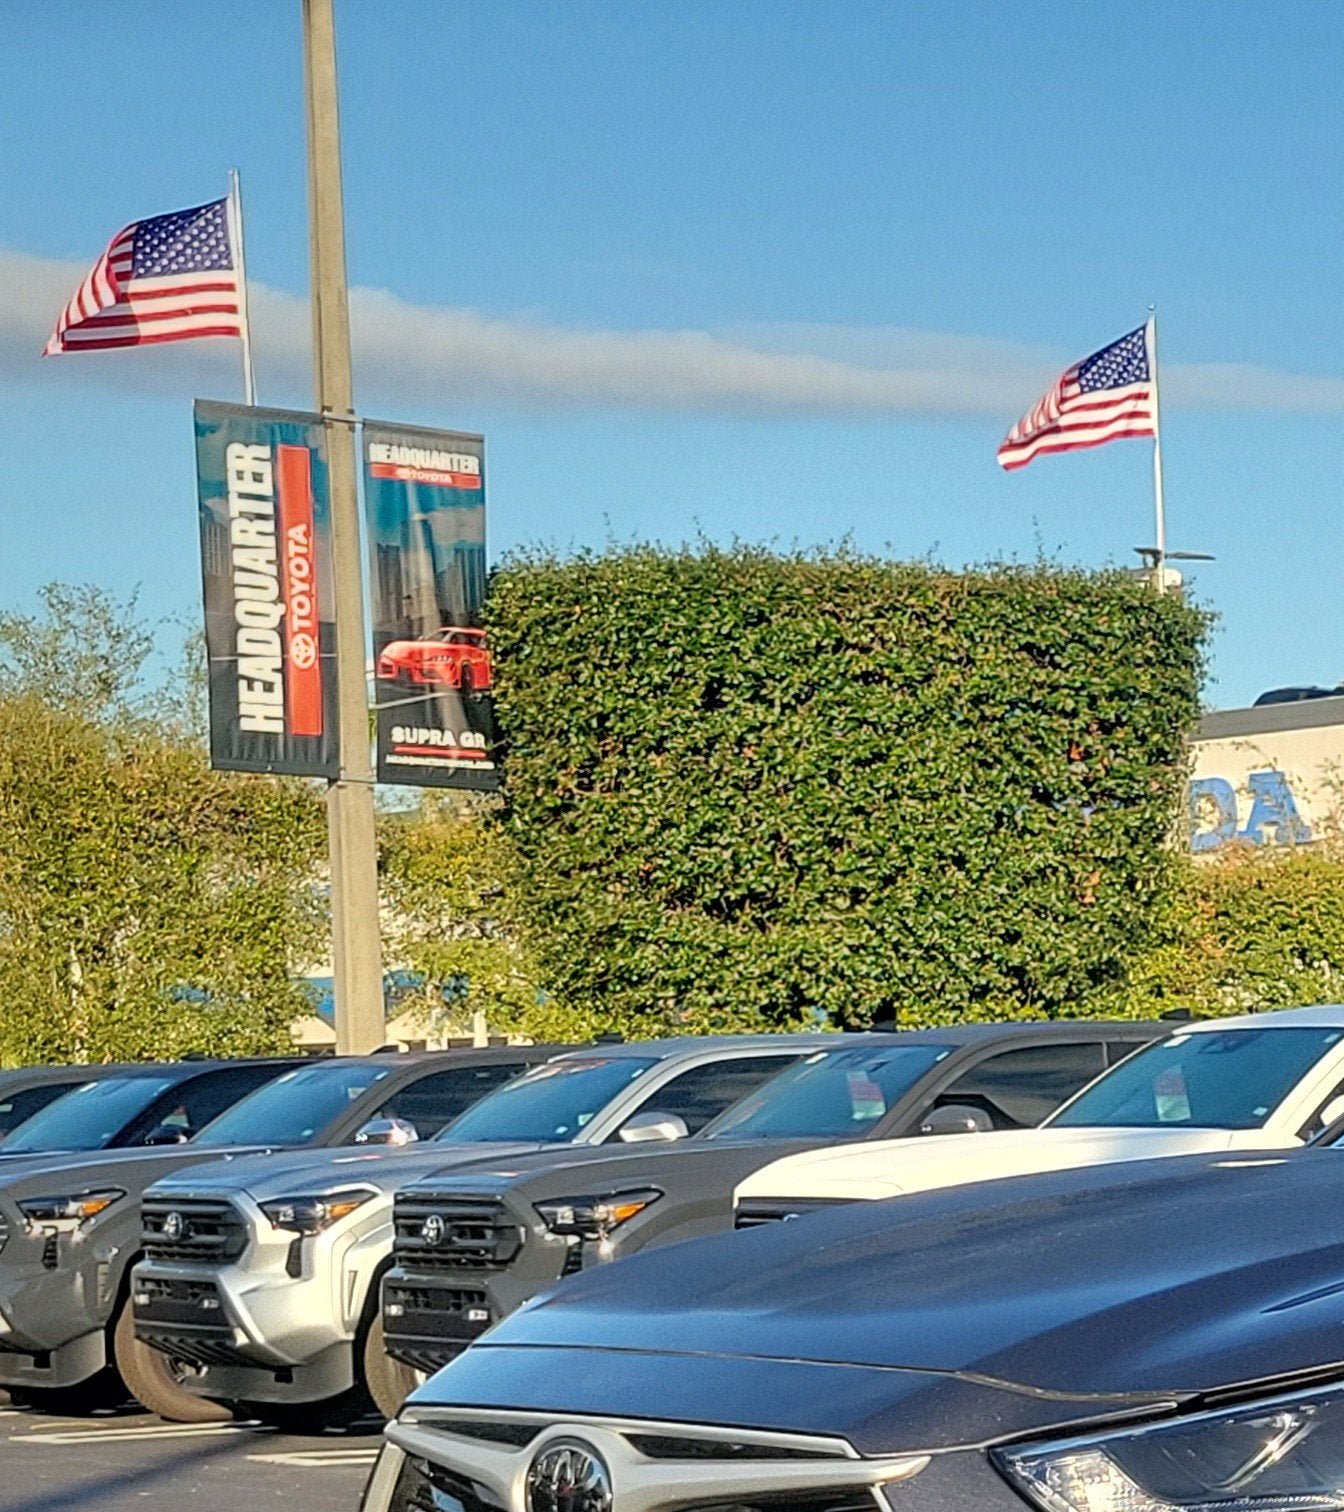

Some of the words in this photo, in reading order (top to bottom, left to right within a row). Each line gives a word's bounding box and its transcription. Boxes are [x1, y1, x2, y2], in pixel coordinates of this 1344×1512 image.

[369, 442, 480, 475] HEADQUARTER
[226, 442, 286, 734] HEADQUARTER
[287, 522, 312, 631] TOYOTA
[391, 726, 457, 747] SUPRA
[460, 731, 486, 749] GR
